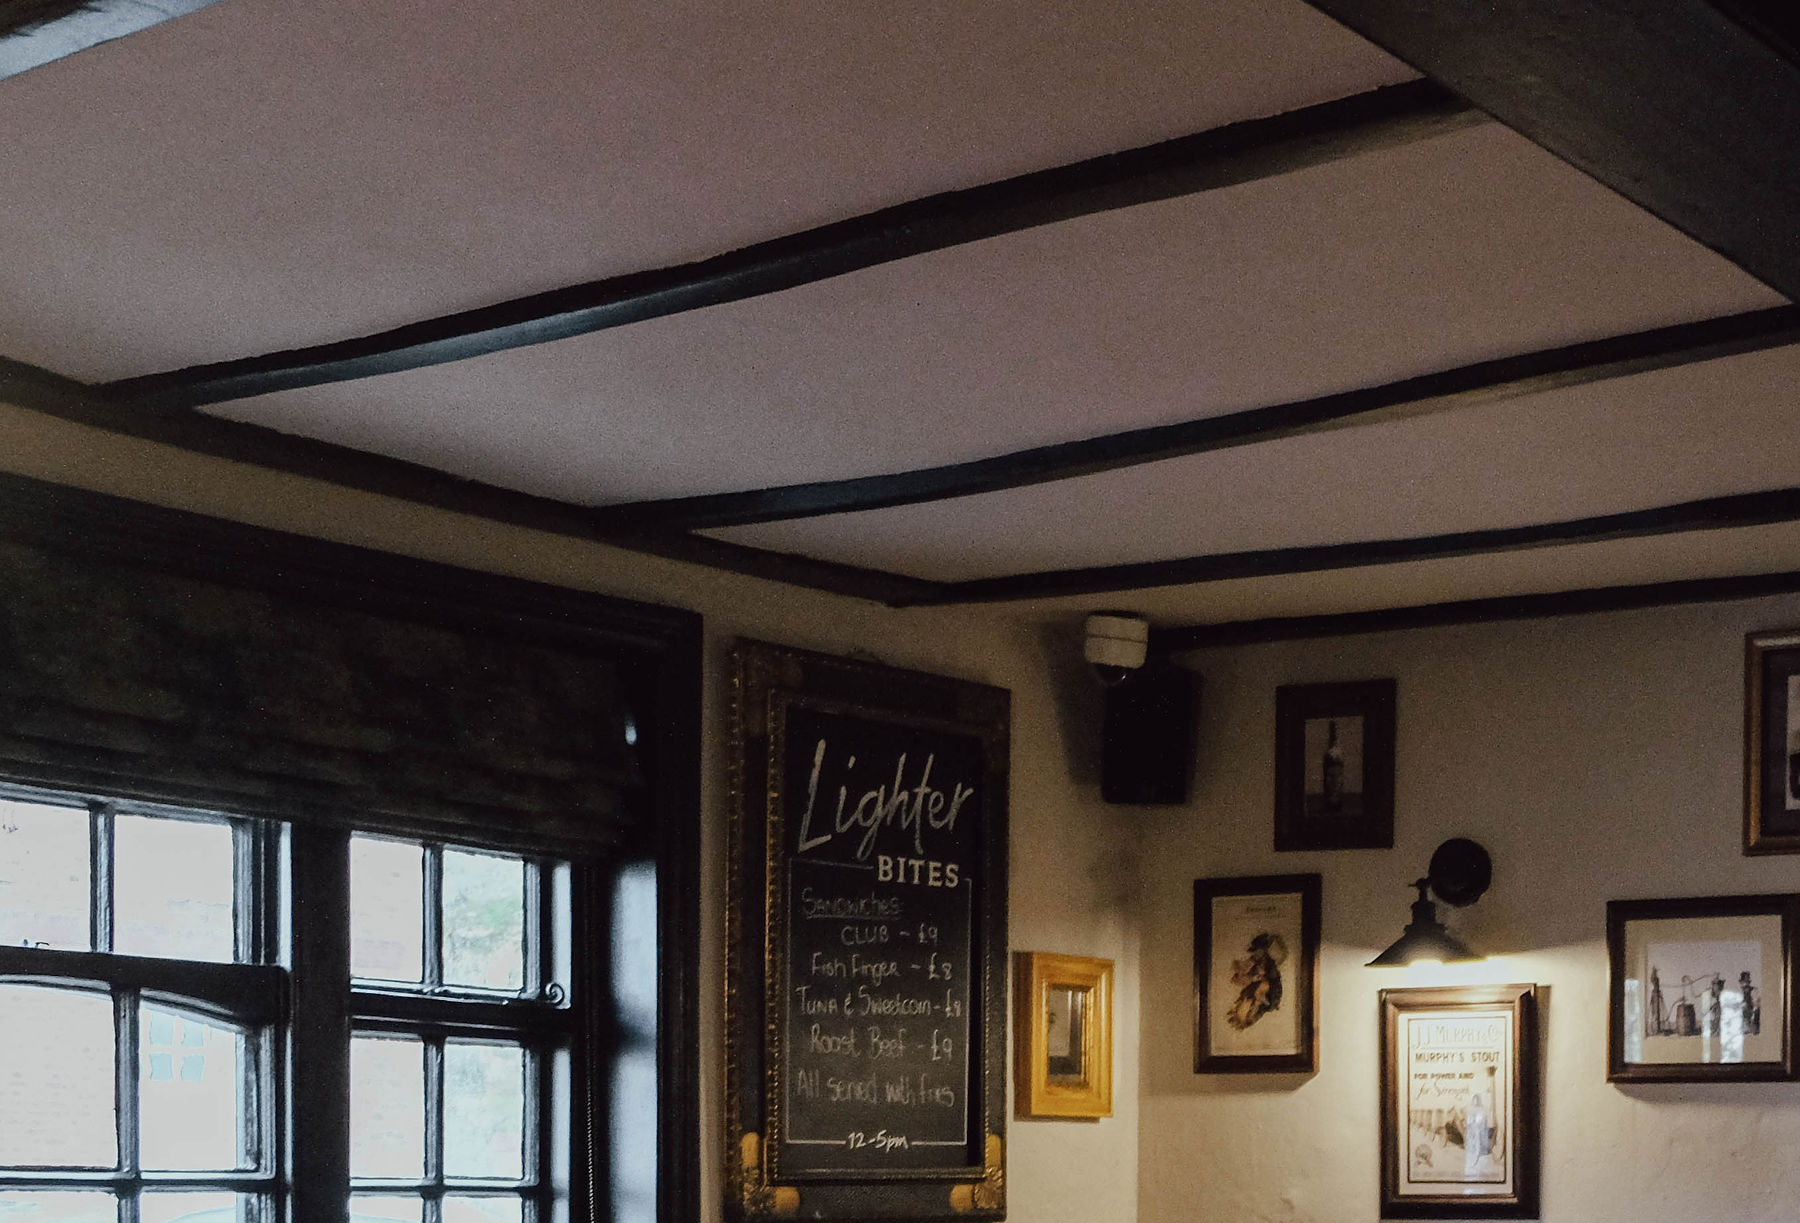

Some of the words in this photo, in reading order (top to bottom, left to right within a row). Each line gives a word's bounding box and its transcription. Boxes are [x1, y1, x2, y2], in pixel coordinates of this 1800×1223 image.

[799, 738, 974, 861] Lighter
[877, 854, 960, 888] BITES
[840, 925, 889, 946] CLUB
[918, 922, 938, 945] £9
[811, 951, 846, 977] Fish
[928, 951, 953, 981] £8
[810, 1023, 862, 1058] Roast
[867, 1026, 906, 1060] Beef
[930, 1028, 953, 1061] £9
[1471, 1050, 1500, 1063] STOUT
[798, 1068, 820, 1099] All
[848, 1129, 909, 1154] 12-5pm
